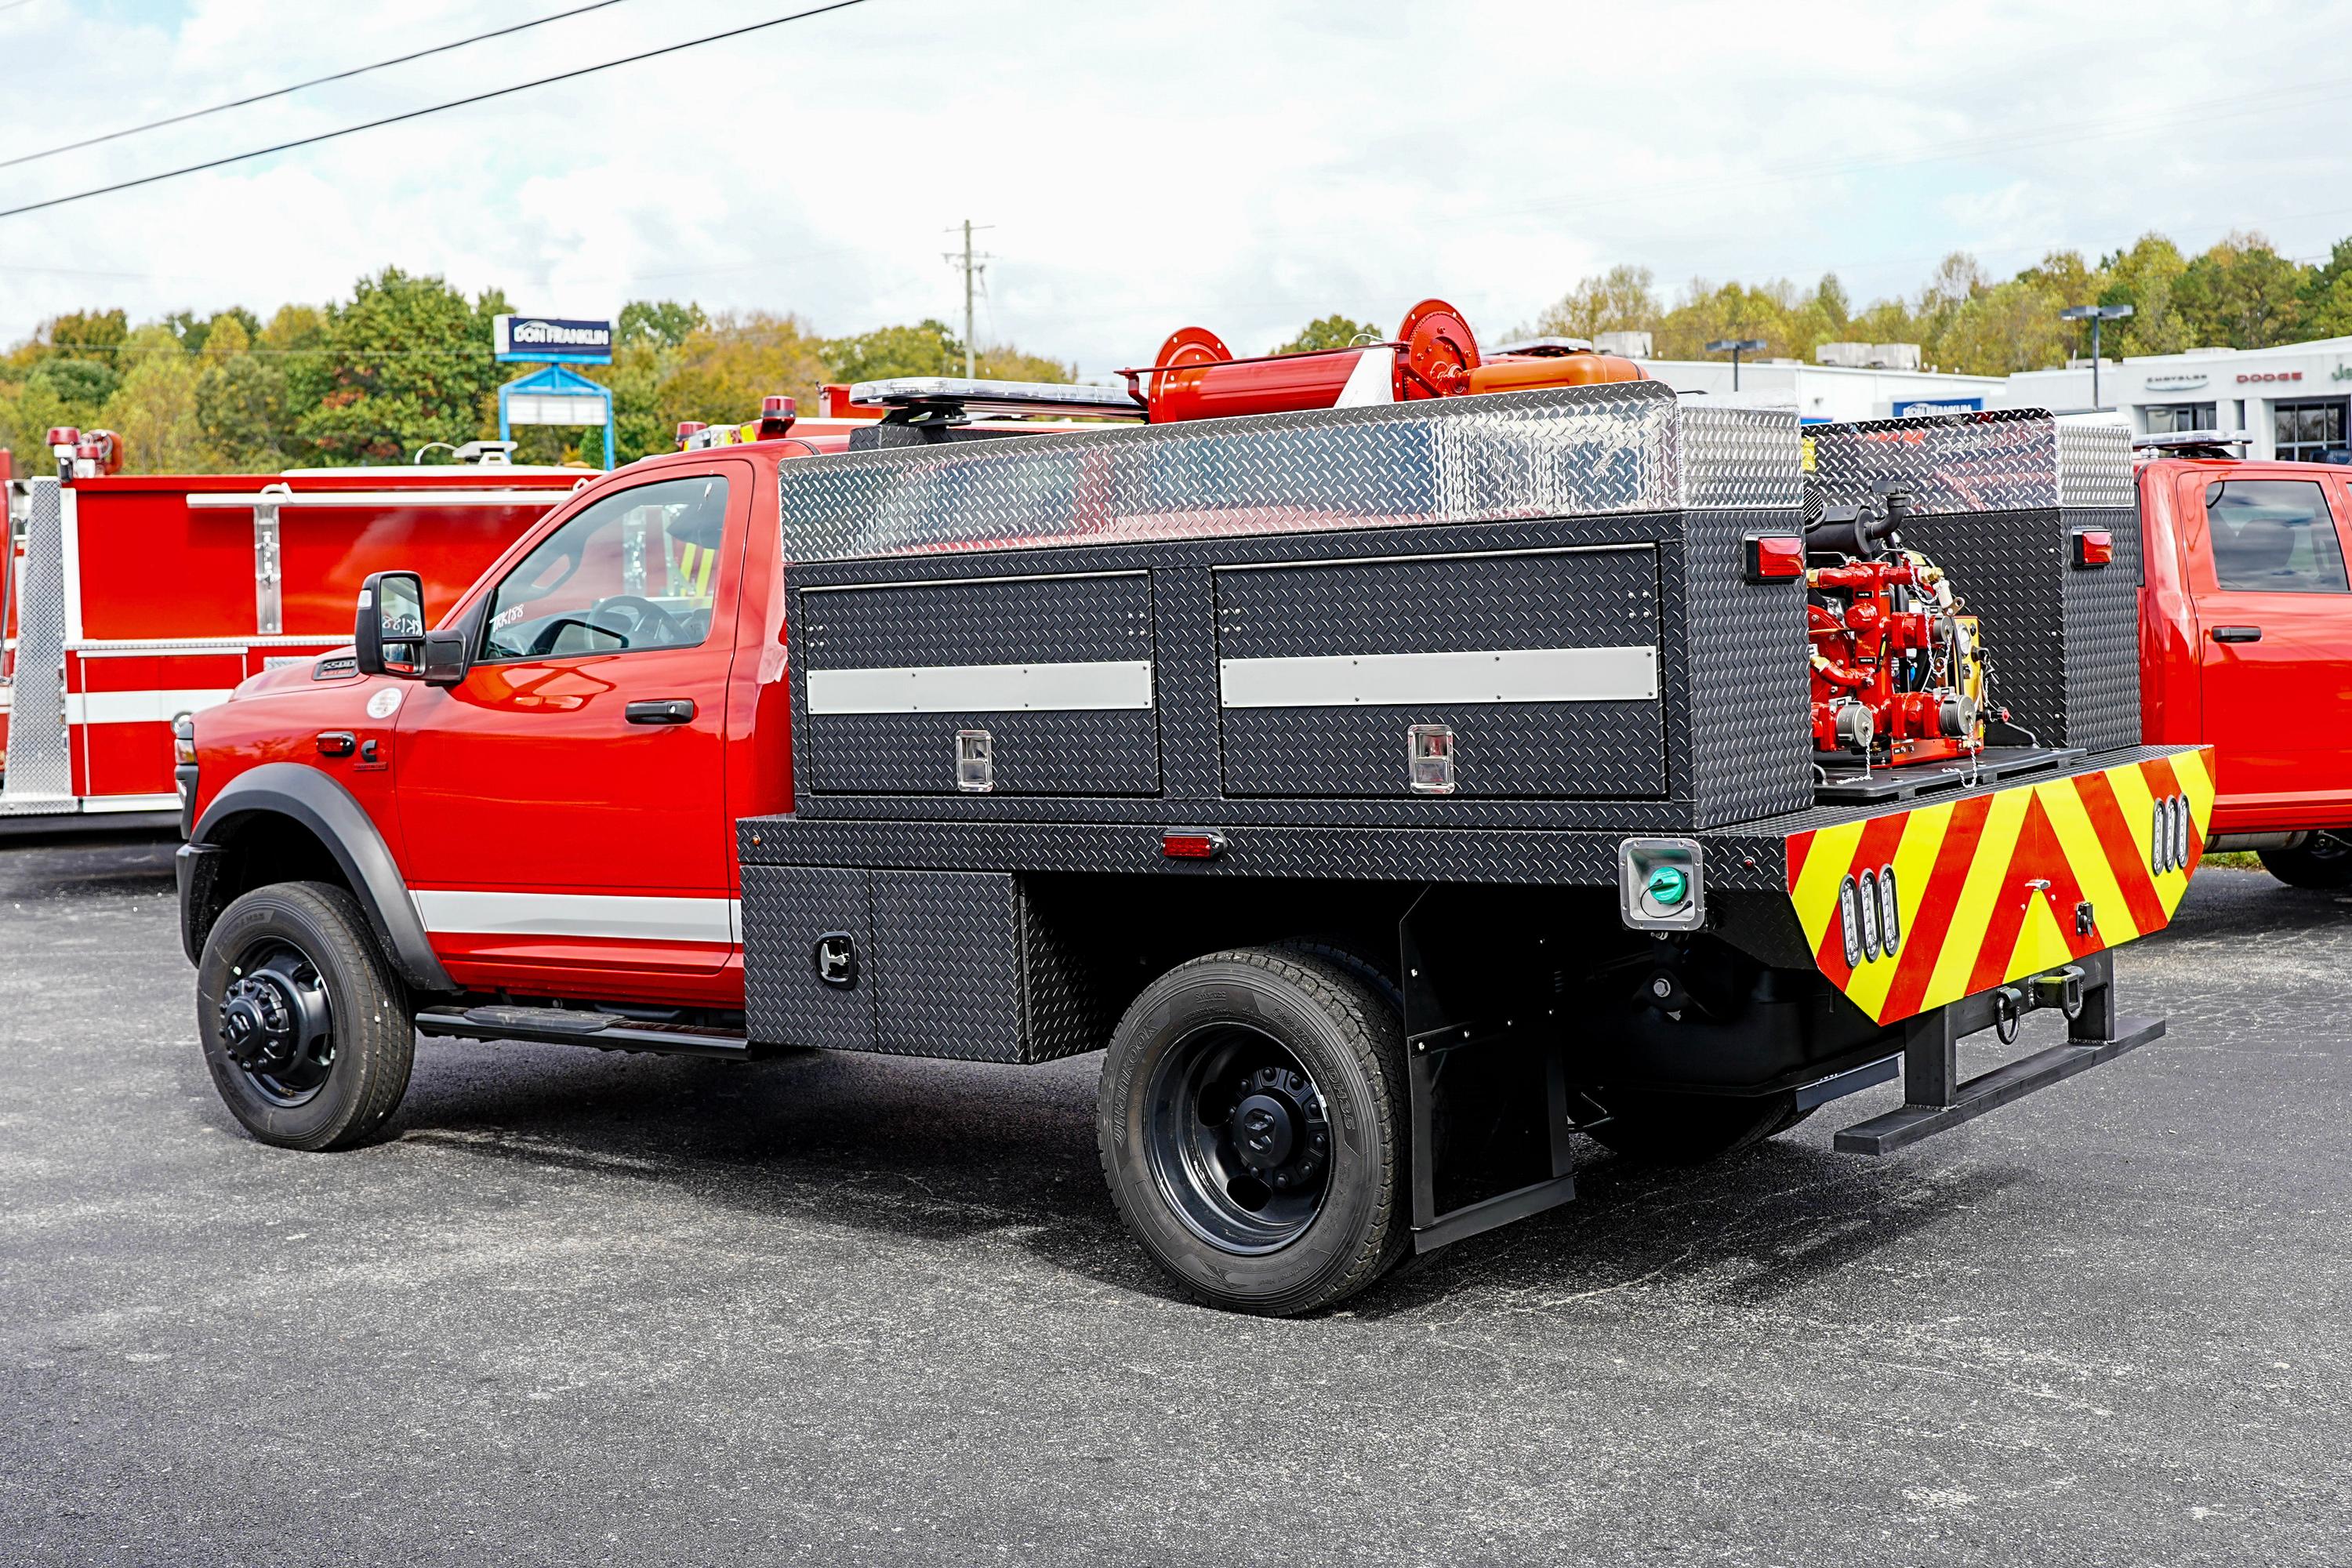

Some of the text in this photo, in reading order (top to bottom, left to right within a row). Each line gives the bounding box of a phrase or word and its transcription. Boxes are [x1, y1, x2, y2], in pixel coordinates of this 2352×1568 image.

[514, 325, 609, 345] DON FRANKLIN
[2147, 374, 2208, 383] CHRYSLER
[2236, 372, 2303, 383] DODGE
[488, 603, 524, 633] TRK188
